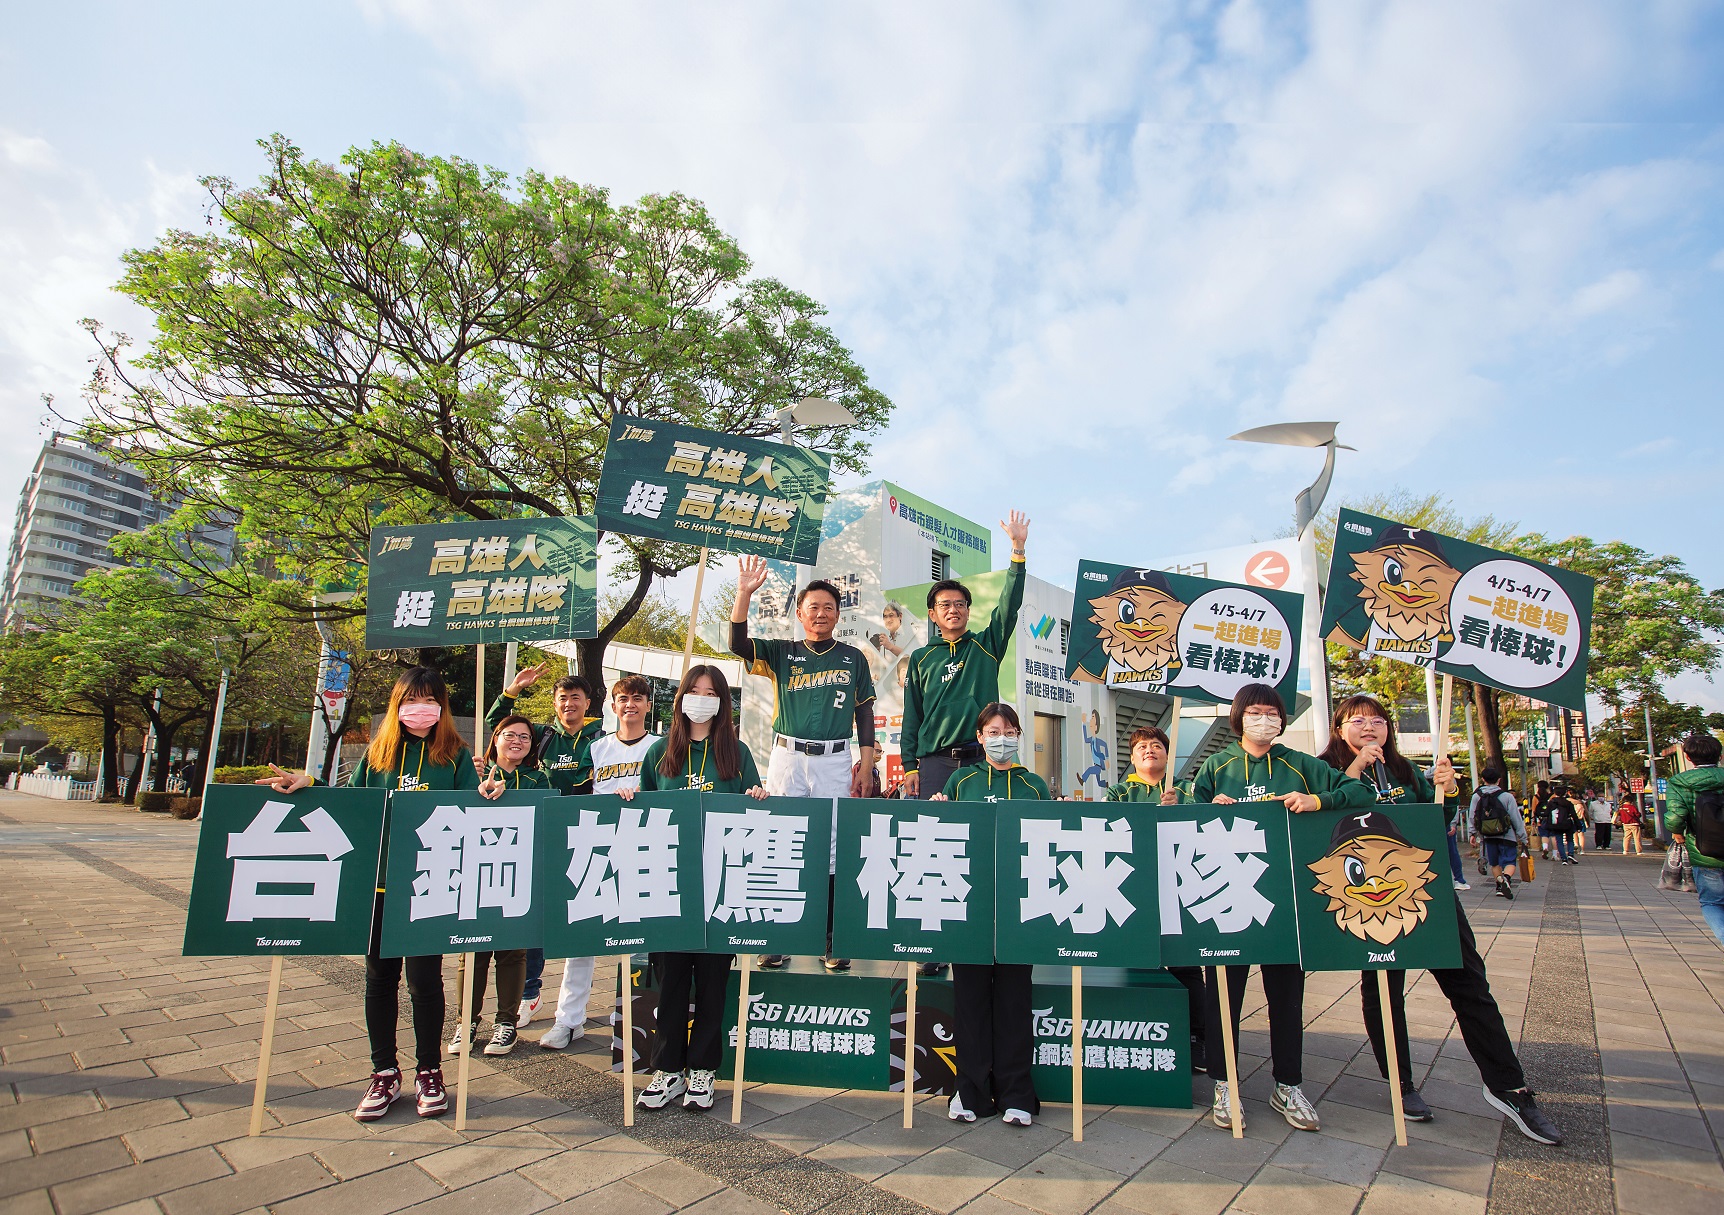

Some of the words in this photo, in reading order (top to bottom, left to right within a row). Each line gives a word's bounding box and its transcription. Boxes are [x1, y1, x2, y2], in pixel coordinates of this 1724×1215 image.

[664, 440, 779, 491] 高雄人
[622, 480, 669, 519] 挺
[676, 482, 798, 532] 高雄隊
[674, 520, 690, 530] TSG
[691, 523, 723, 535] HAWKS
[725, 528, 785, 546] 台鋼雄鷹棒球隊
[429, 533, 546, 576] 高雄人
[1487, 574, 1551, 602] 4/5-4/7
[393, 589, 436, 628] 挺
[446, 575, 569, 617] 高雄隊
[1210, 602, 1266, 622] 4/5-4/7
[446, 621, 462, 630] TSG
[463, 619, 496, 630] HAWKS
[498, 615, 560, 628] 台鋼雄鷹棒球隊
[1467, 594, 1570, 636] 一起進場
[1193, 620, 1282, 651] 一起進場
[1375, 638, 1433, 653] HAWKS
[1459, 614, 1567, 669] 看棒球!
[1185, 642, 1281, 679] 看棒球!
[787, 669, 852, 692] HAWKS
[1113, 669, 1163, 685] HAWKS
[833, 690, 847, 709] 2
[550, 761, 578, 770] HAWKS
[1244, 783, 1266, 797] TSG
[226, 800, 354, 922] 台
[410, 805, 536, 922] 鋼
[565, 807, 682, 924] 雄
[704, 808, 809, 924] 鷹
[856, 813, 972, 931] 棒
[1020, 816, 1137, 934] 球
[1157, 816, 1275, 935] 隊
[256, 936, 271, 947] TSG
[271, 938, 302, 947] HAWKS
[449, 934, 464, 944] TSG
[464, 935, 493, 944] HAWKS
[604, 936, 619, 947] TSG
[619, 937, 645, 946] HAWKS
[727, 935, 742, 945] TSG
[742, 938, 767, 946] HAWKS
[893, 943, 907, 953] TSG
[907, 946, 933, 954] HAWKS
[1057, 947, 1071, 957] TSG
[1071, 950, 1098, 958] HAWKS
[1199, 947, 1213, 957] TSG
[1213, 949, 1241, 957] HAWKS
[784, 1004, 871, 1027] HAWKS
[1082, 1019, 1170, 1041] HAWKS
